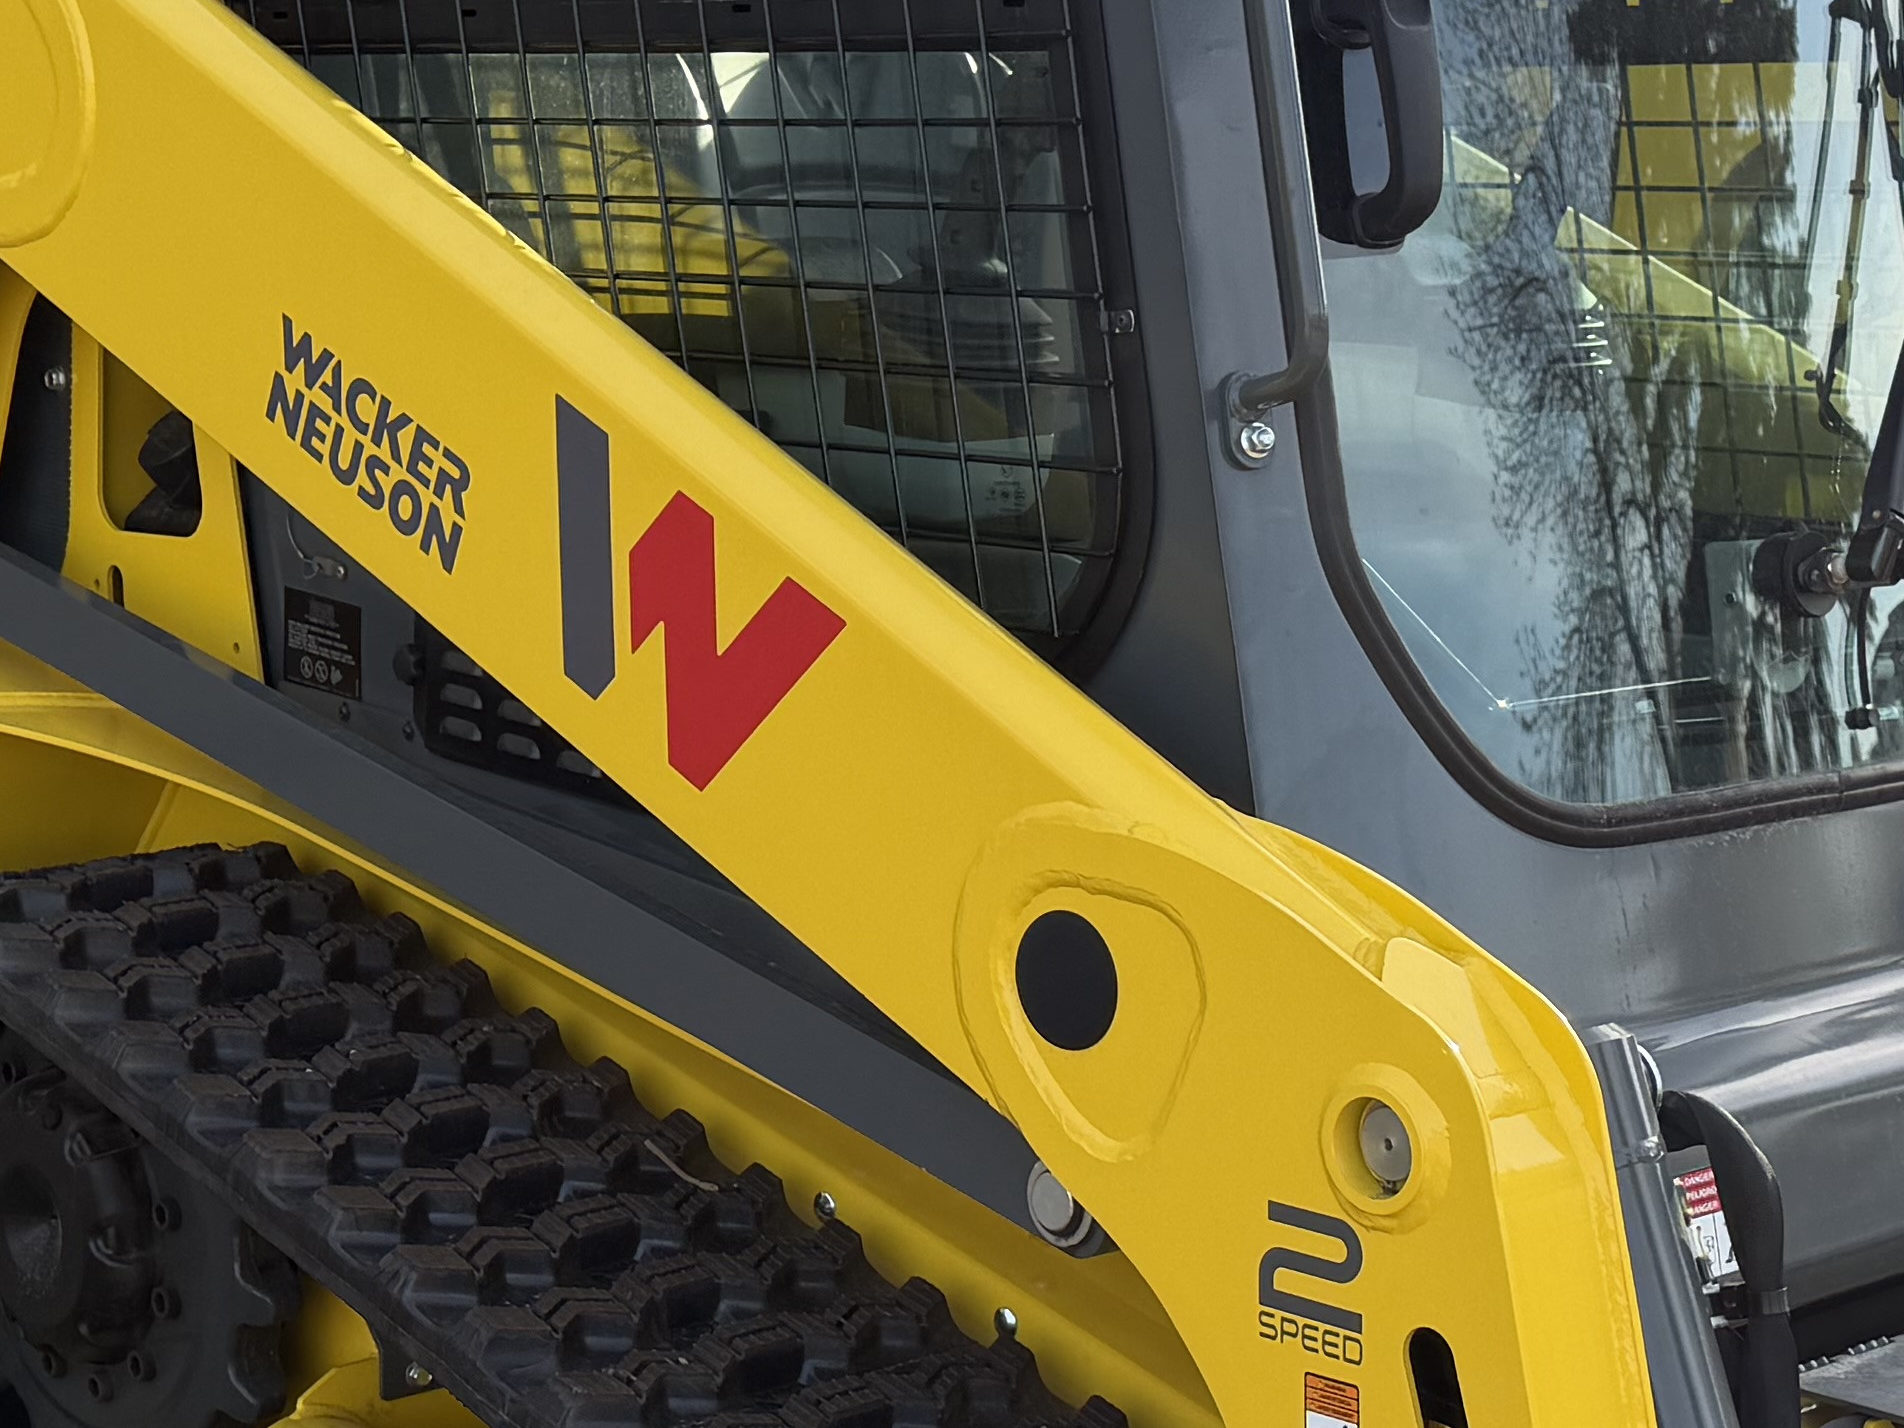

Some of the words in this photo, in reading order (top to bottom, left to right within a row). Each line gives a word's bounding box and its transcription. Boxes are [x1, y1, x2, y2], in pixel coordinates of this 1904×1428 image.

[265, 370, 464, 575] NEUSON
[281, 313, 471, 521] WACKER
[1258, 1199, 1363, 1335] 2
[1258, 1310, 1363, 1366] SPEED
